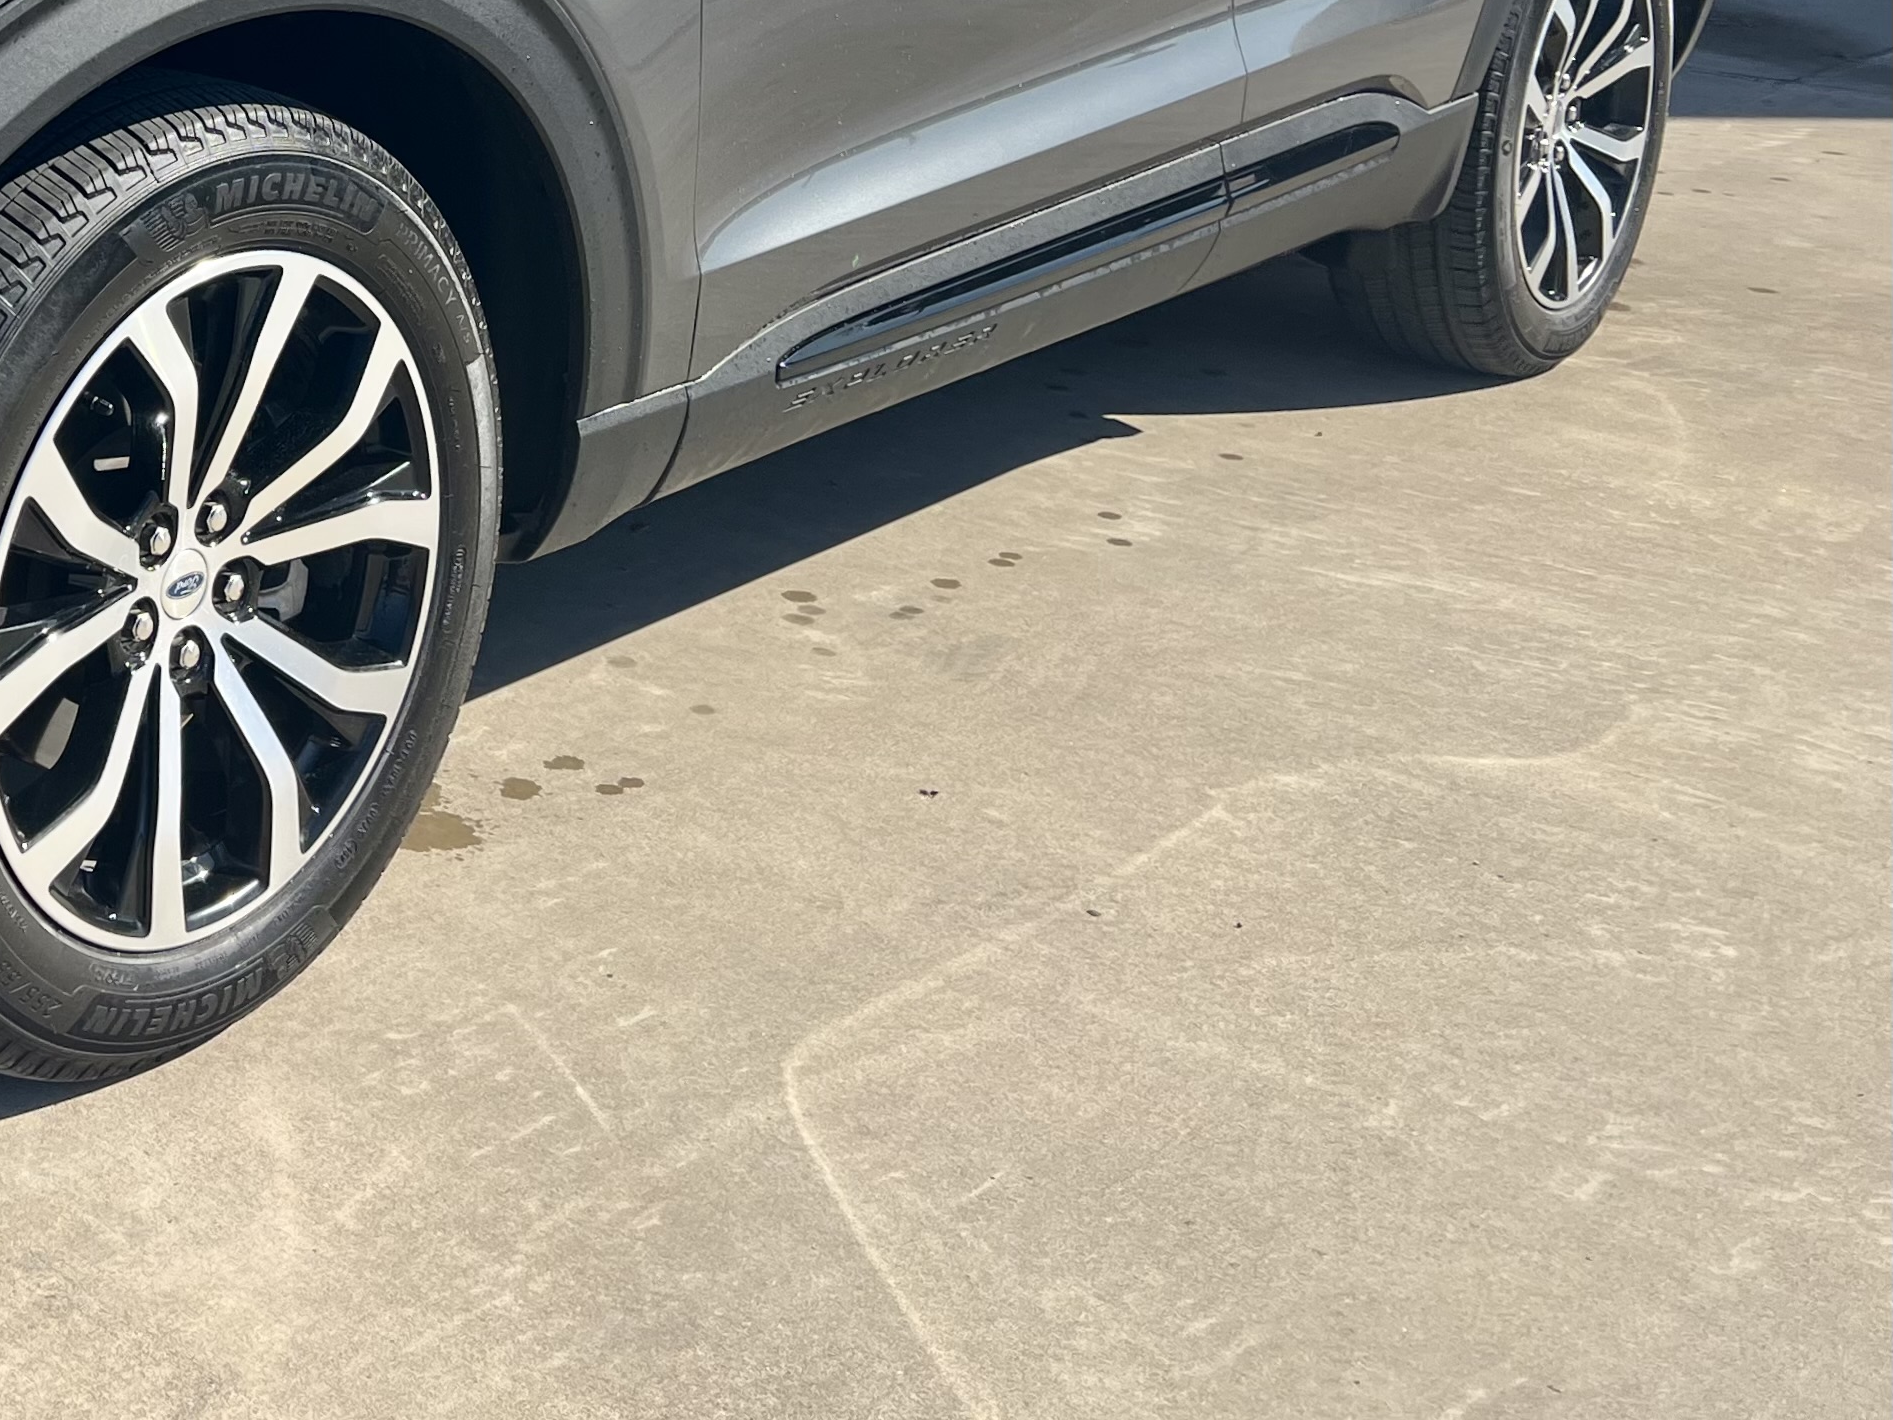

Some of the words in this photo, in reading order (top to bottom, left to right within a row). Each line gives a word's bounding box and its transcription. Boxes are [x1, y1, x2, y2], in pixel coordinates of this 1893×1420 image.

[214, 172, 378, 222] MICHELIN
[395, 222, 457, 306] PRIMACY
[174, 575, 199, 594] Ford
[82, 966, 263, 1036] MICHELIN
